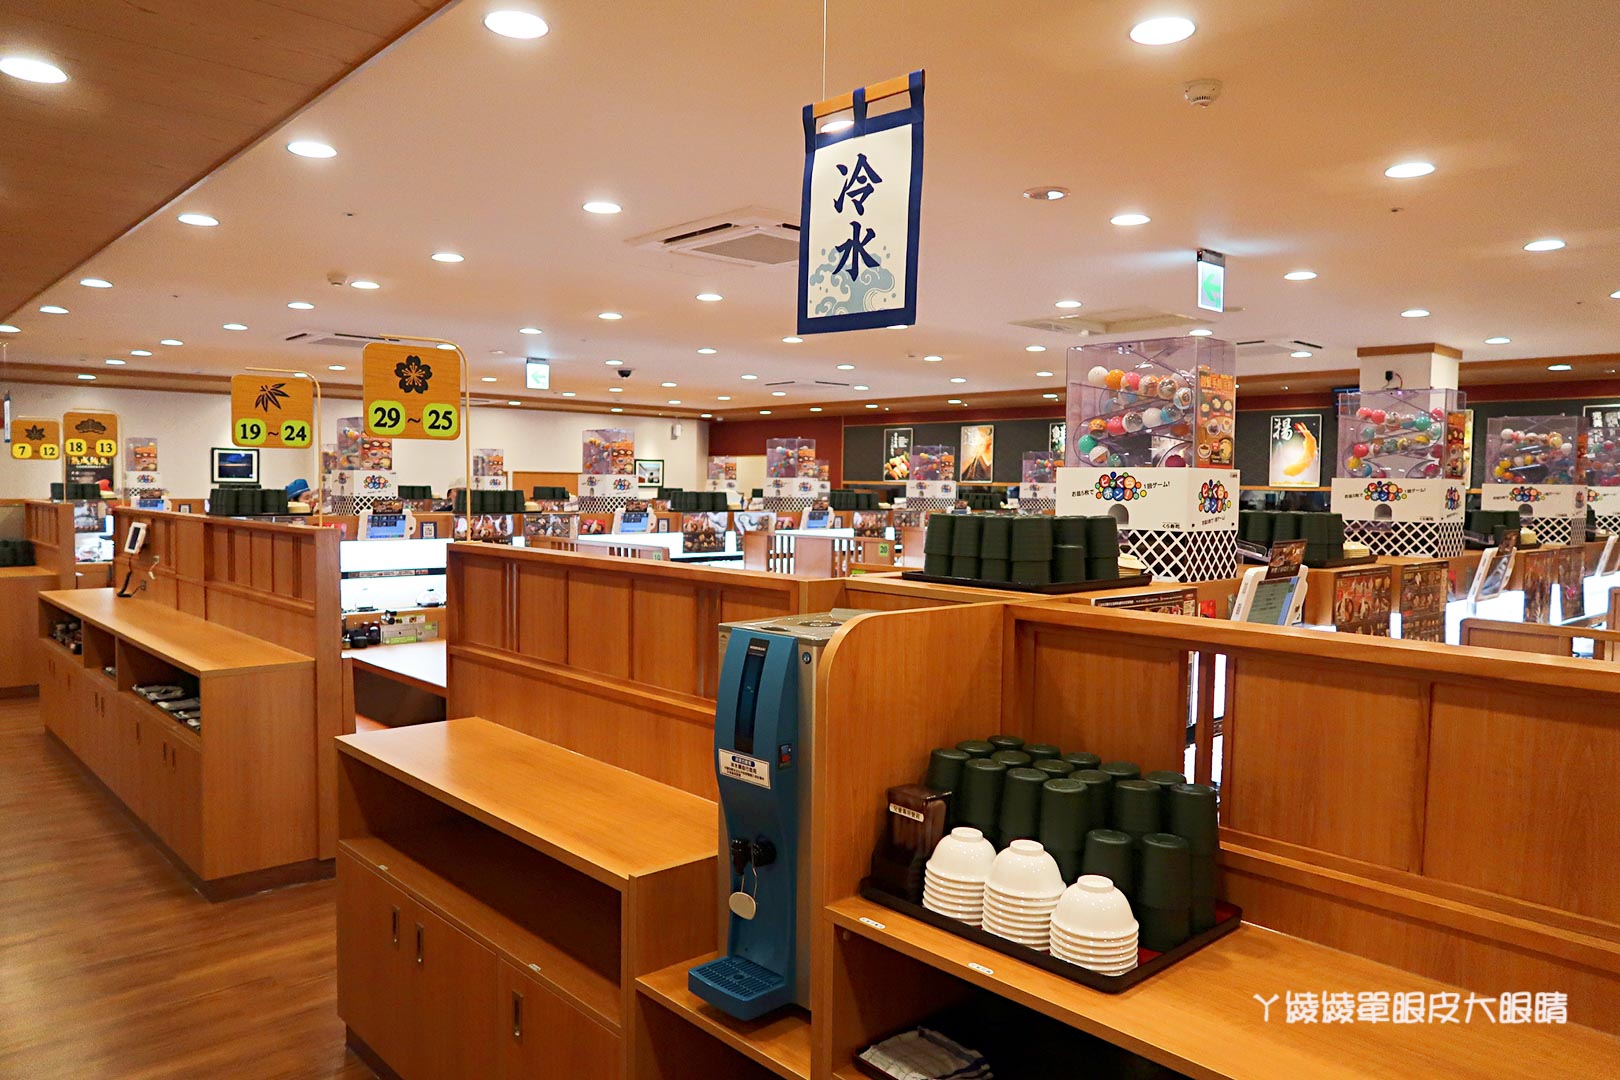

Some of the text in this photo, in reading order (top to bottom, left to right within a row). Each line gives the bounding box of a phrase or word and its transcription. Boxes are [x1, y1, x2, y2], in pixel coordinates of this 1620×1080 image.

[832, 152, 883, 282] 冷水
[373, 406, 401, 429] 29
[428, 409, 453, 431] 25
[240, 423, 262, 440] 19
[284, 425, 307, 442] 24
[18, 446, 26, 456] 7
[43, 447, 55, 456] 12
[70, 442, 83, 453] 18
[99, 443, 113, 453] 13
